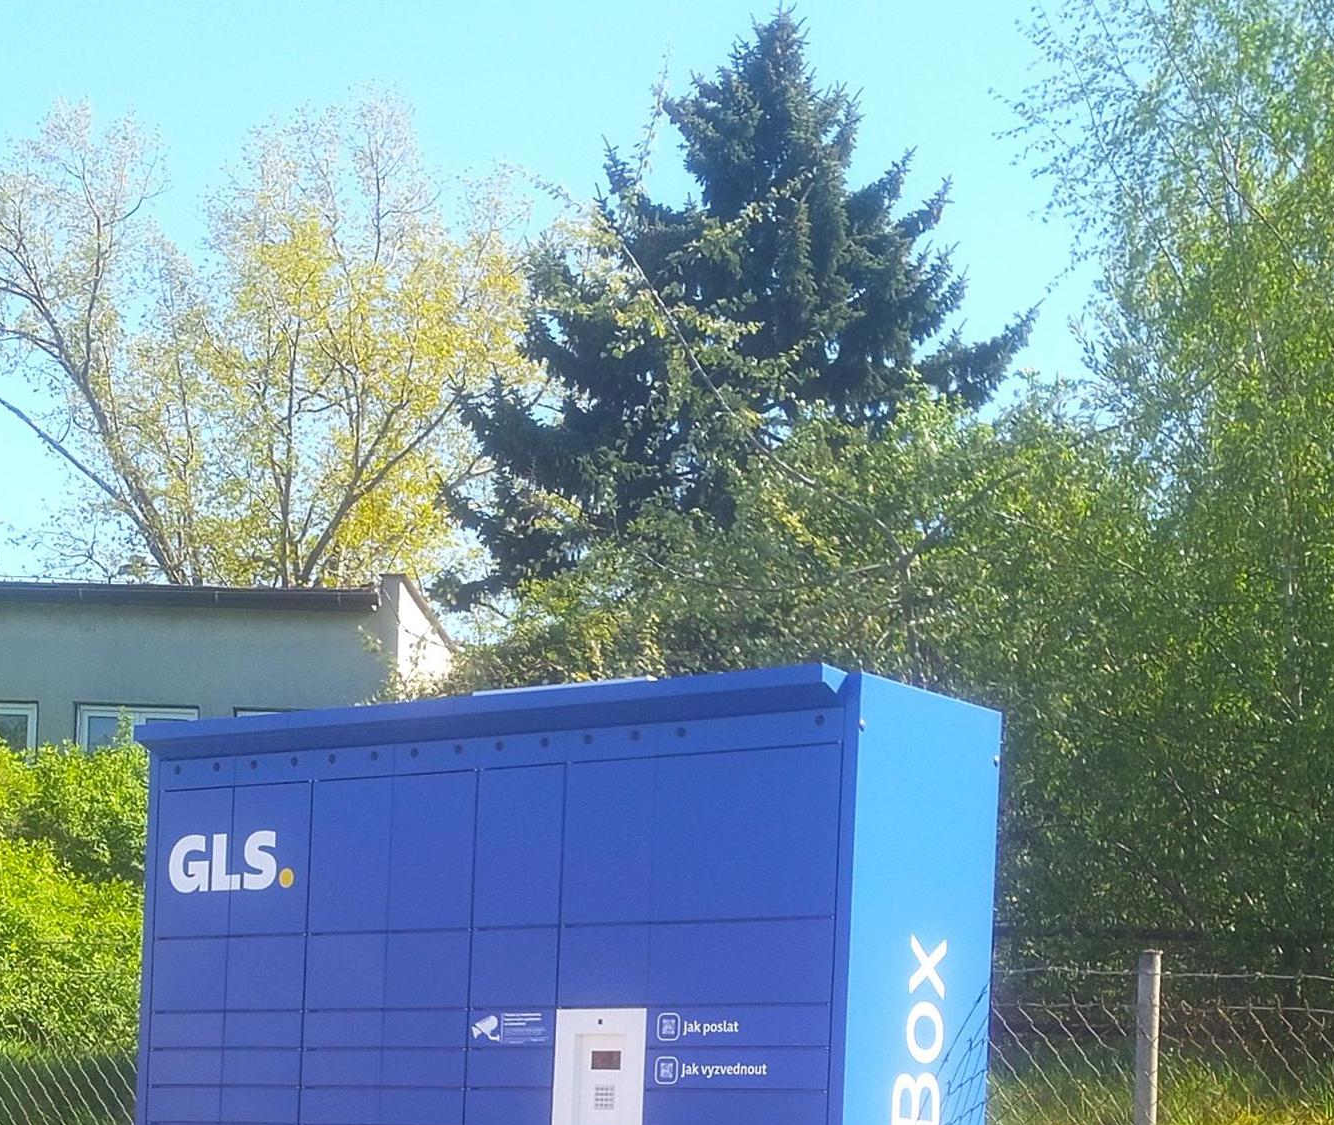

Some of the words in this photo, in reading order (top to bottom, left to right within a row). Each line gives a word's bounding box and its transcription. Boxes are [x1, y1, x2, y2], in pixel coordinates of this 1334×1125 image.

[682, 1020, 701, 1036] Jak
[703, 1020, 739, 1036] poslat
[680, 1062, 699, 1078] Jak
[701, 1062, 768, 1079] vyzvednout
